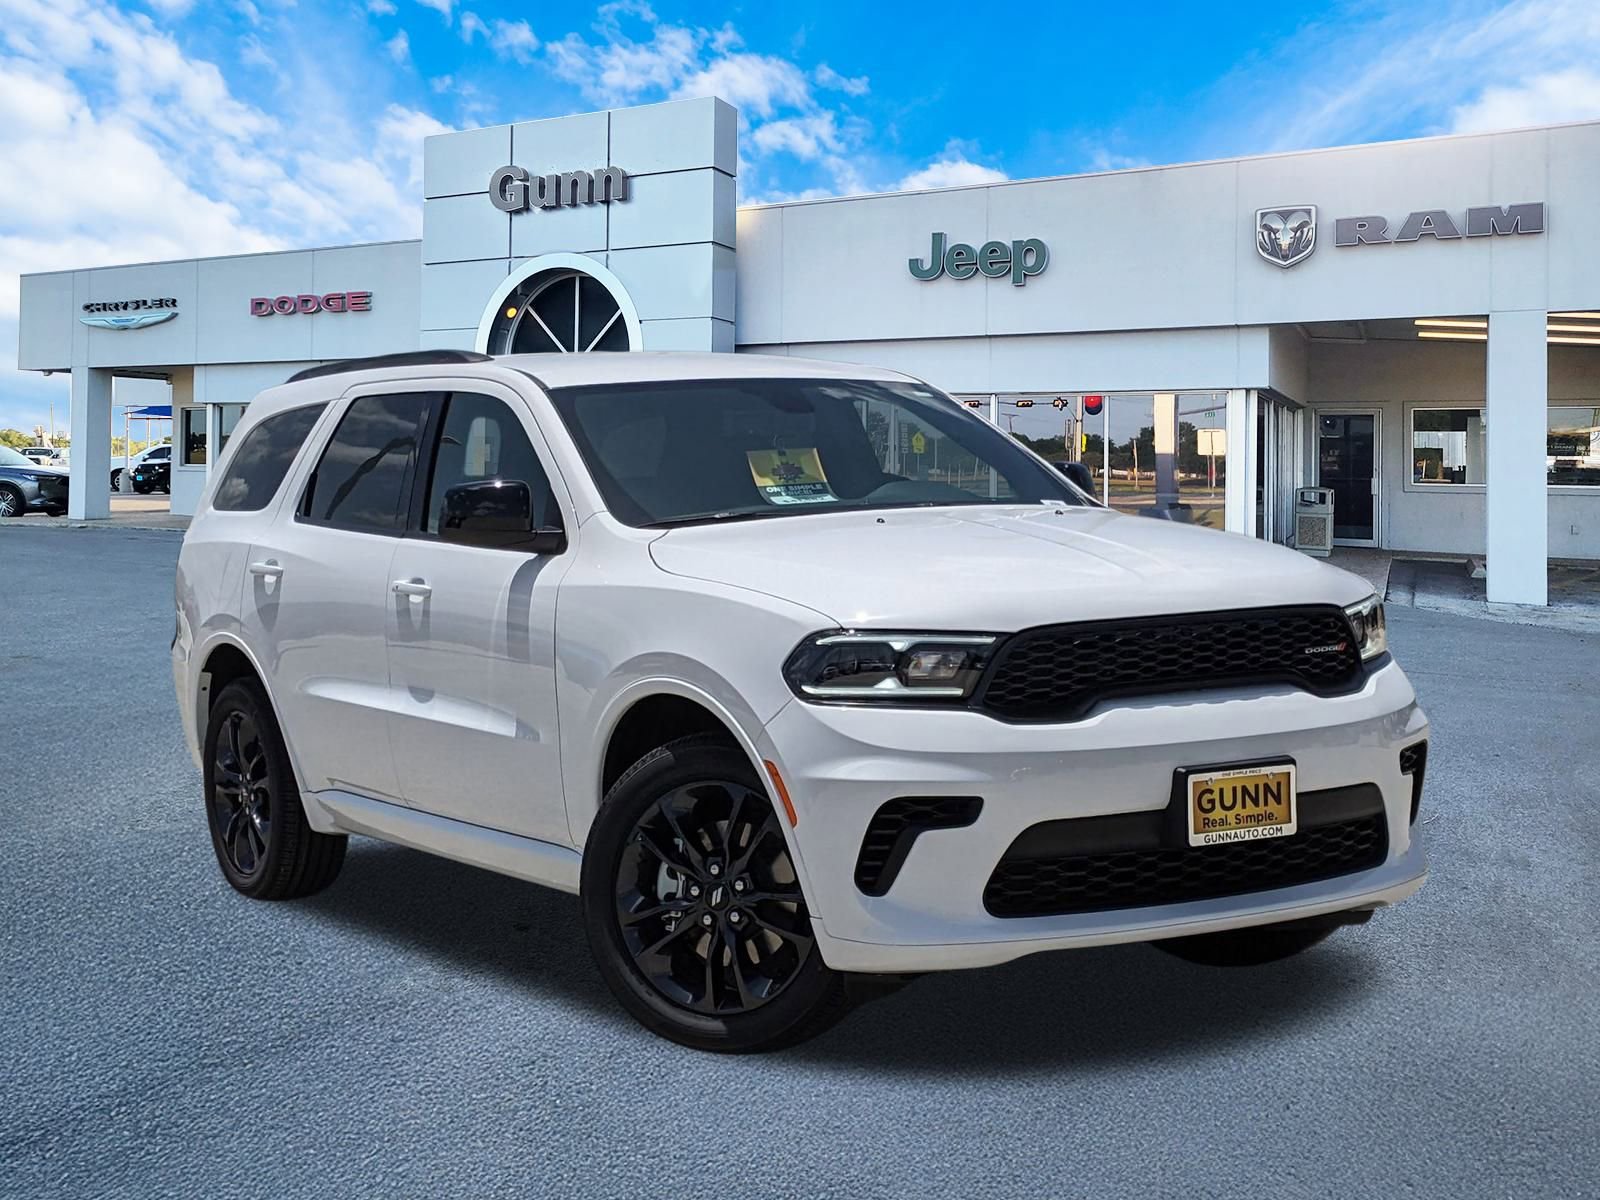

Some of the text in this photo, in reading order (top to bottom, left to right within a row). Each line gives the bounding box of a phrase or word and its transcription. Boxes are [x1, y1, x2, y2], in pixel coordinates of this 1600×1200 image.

[489, 165, 628, 212] Gunn
[1335, 202, 1545, 247] RAM
[908, 232, 1050, 286] Jeep
[82, 298, 177, 313] CHRYSLER
[250, 291, 373, 317] DODGE
[1197, 781, 1282, 814] GUNN
[1203, 814, 1231, 828] Real.
[1203, 826, 1283, 844] GUNNAUTO.COM
